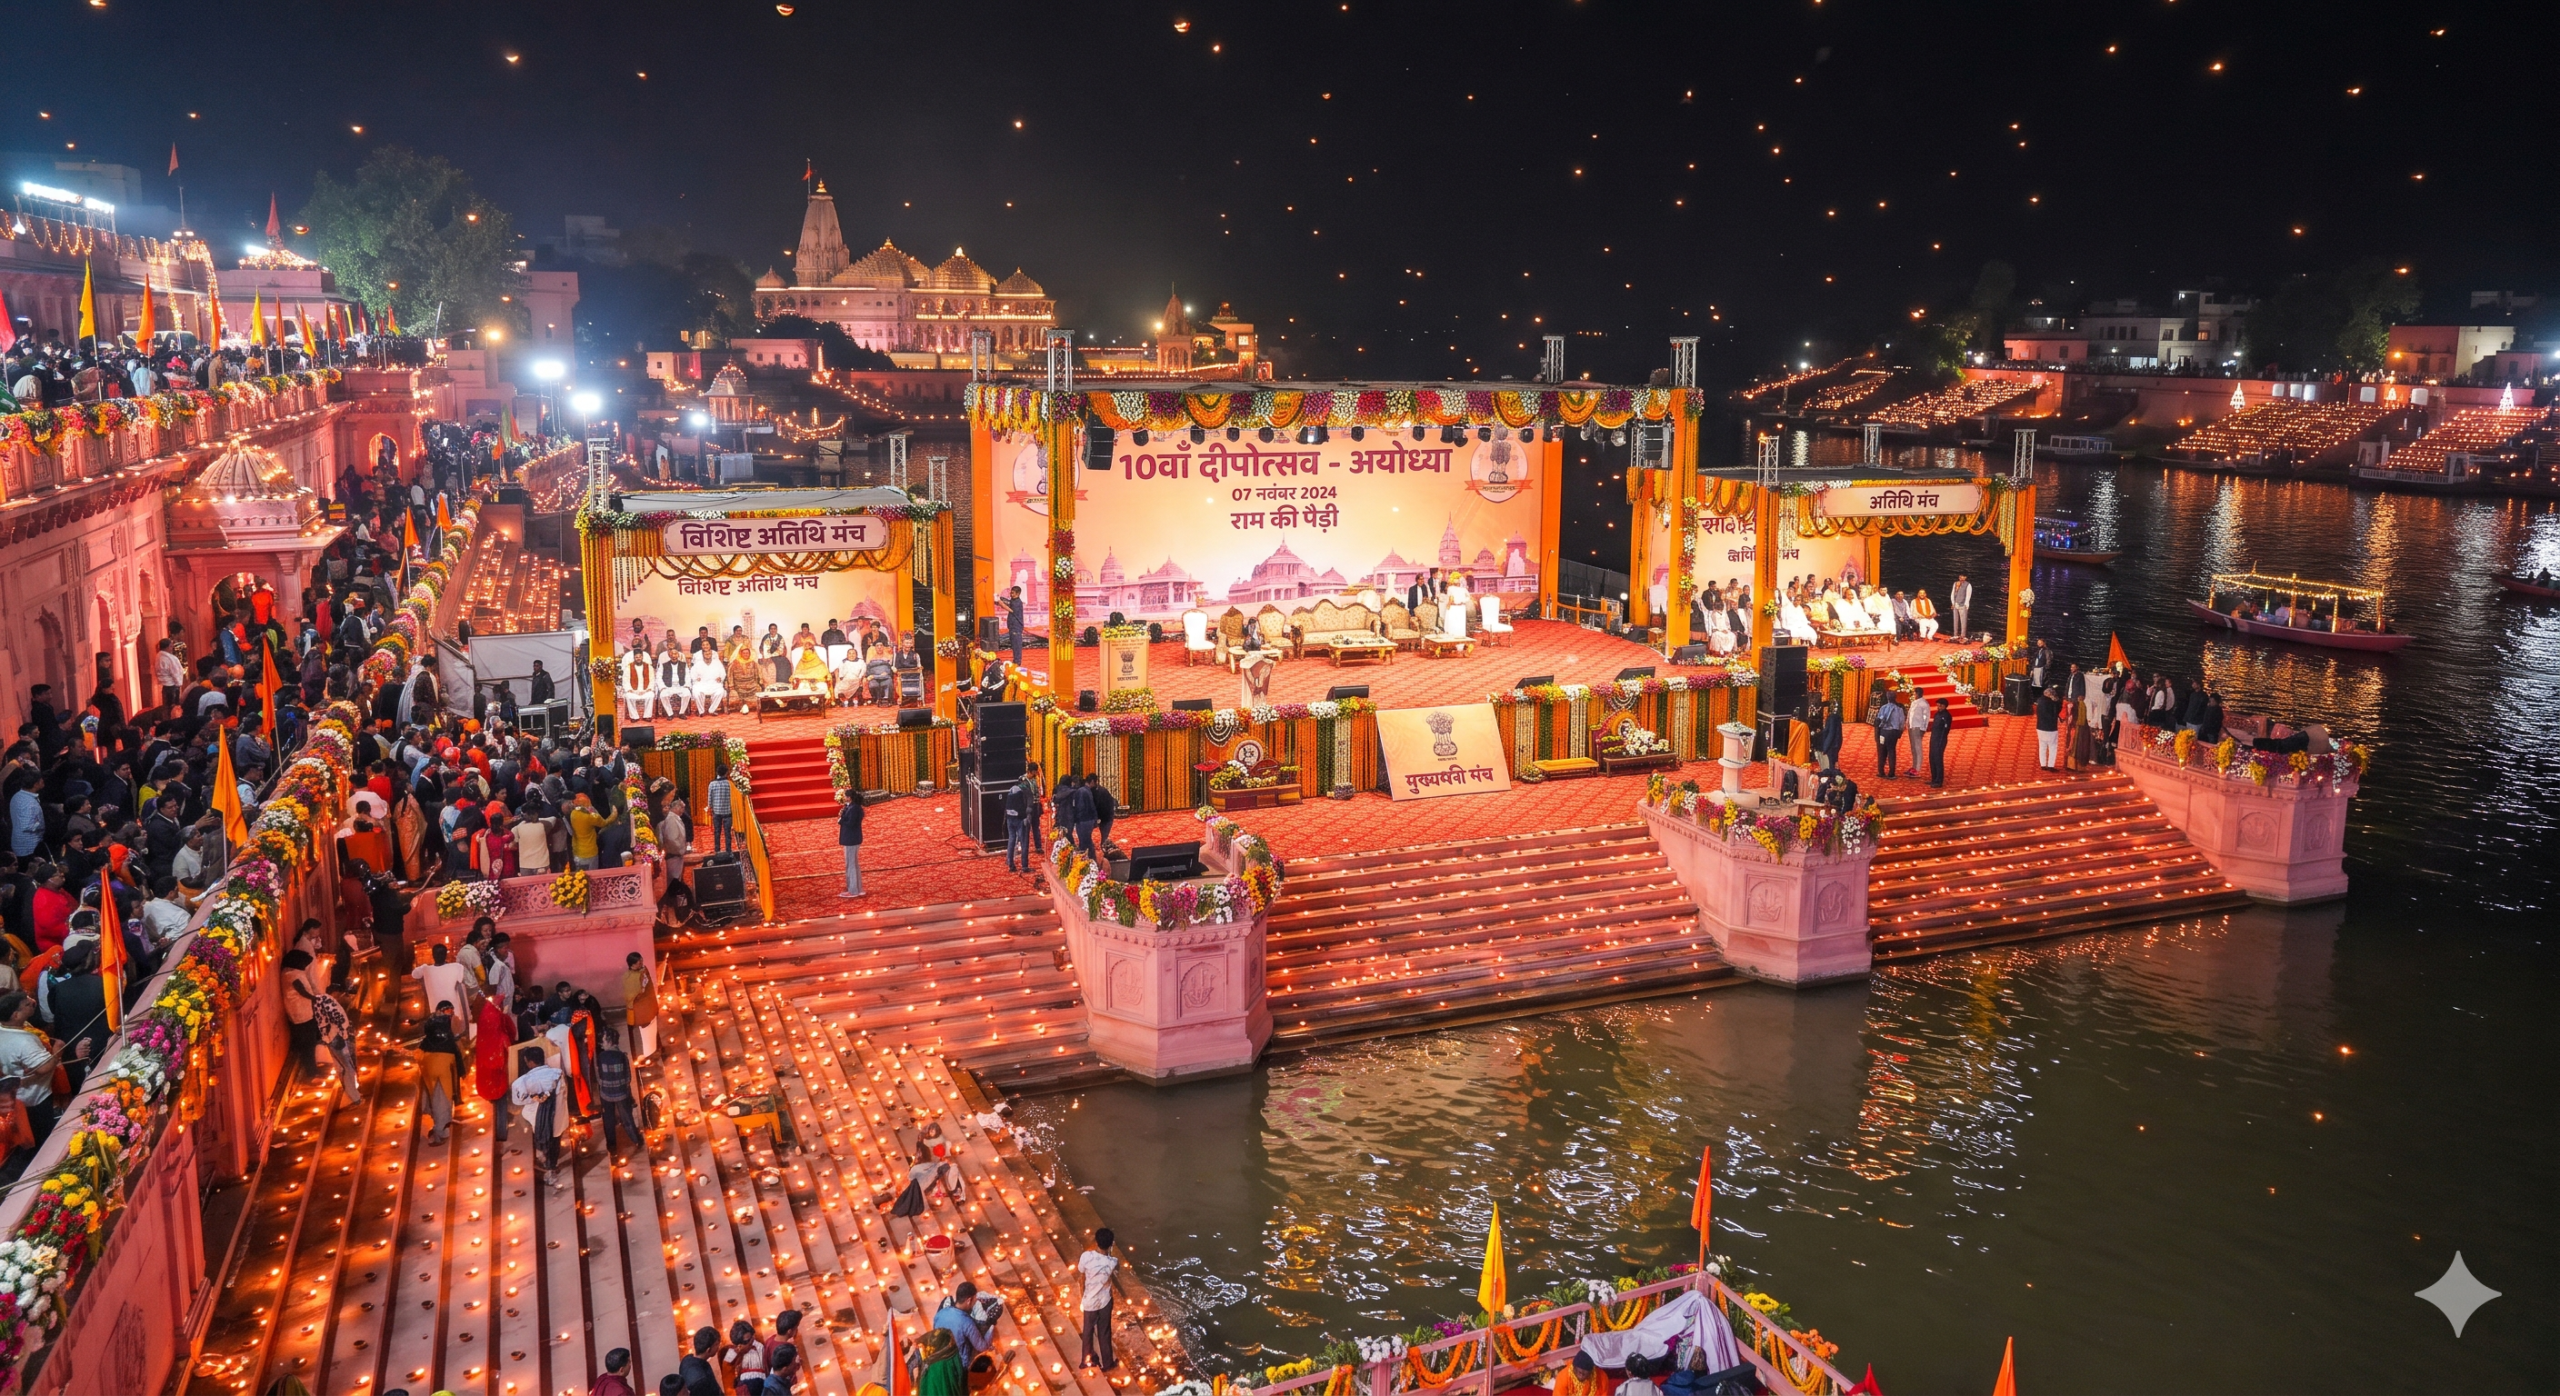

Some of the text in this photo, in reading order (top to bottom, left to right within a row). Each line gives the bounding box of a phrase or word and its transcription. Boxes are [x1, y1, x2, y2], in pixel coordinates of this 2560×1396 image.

[1119, 440, 1191, 480] 10वाँ
[1198, 442, 1321, 483] दीपोत्सव
[1349, 440, 1453, 474] अयोध्या
[1232, 488, 1252, 501] 07
[1300, 486, 1337, 500] 2024
[1870, 490, 1939, 509] अतिथि मंच
[1230, 503, 1339, 533] राम की पैड़ी
[680, 520, 866, 549] विशिष्ट अतिथि मंच
[737, 573, 788, 593] अतिथि
[793, 574, 819, 589] मंच
[1468, 764, 1493, 782] मंच
